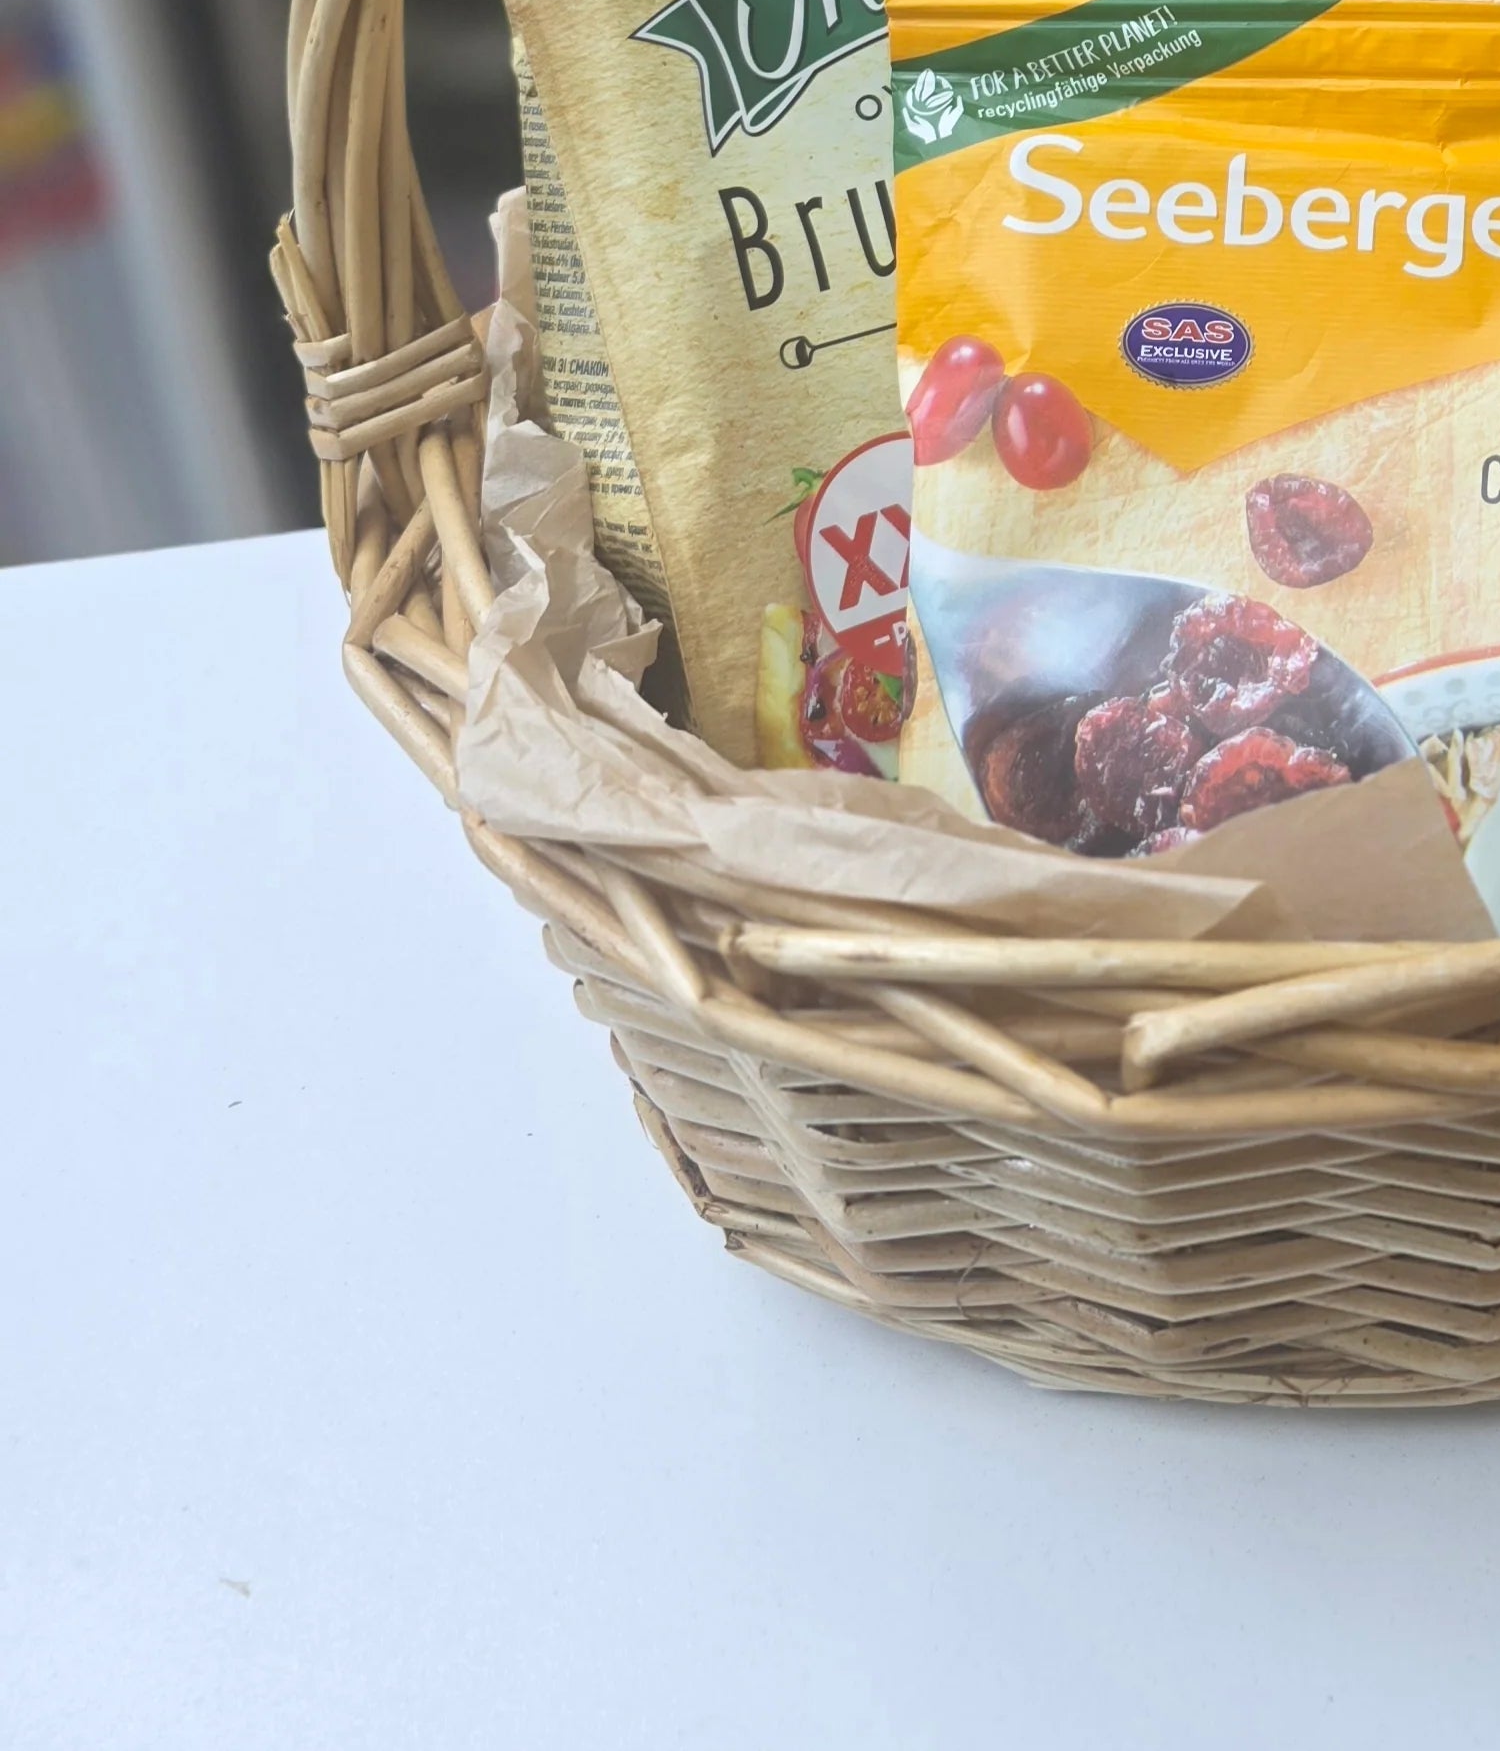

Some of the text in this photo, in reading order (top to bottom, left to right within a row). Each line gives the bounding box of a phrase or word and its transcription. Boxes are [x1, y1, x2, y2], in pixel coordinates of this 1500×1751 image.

[969, 4, 1177, 101] FOR A BETTER PLANET!
[977, 28, 1203, 120] recyclingfähige Verpackung
[1140, 345, 1233, 361] EXCLUSIVE
[1141, 317, 1235, 344] SAS
